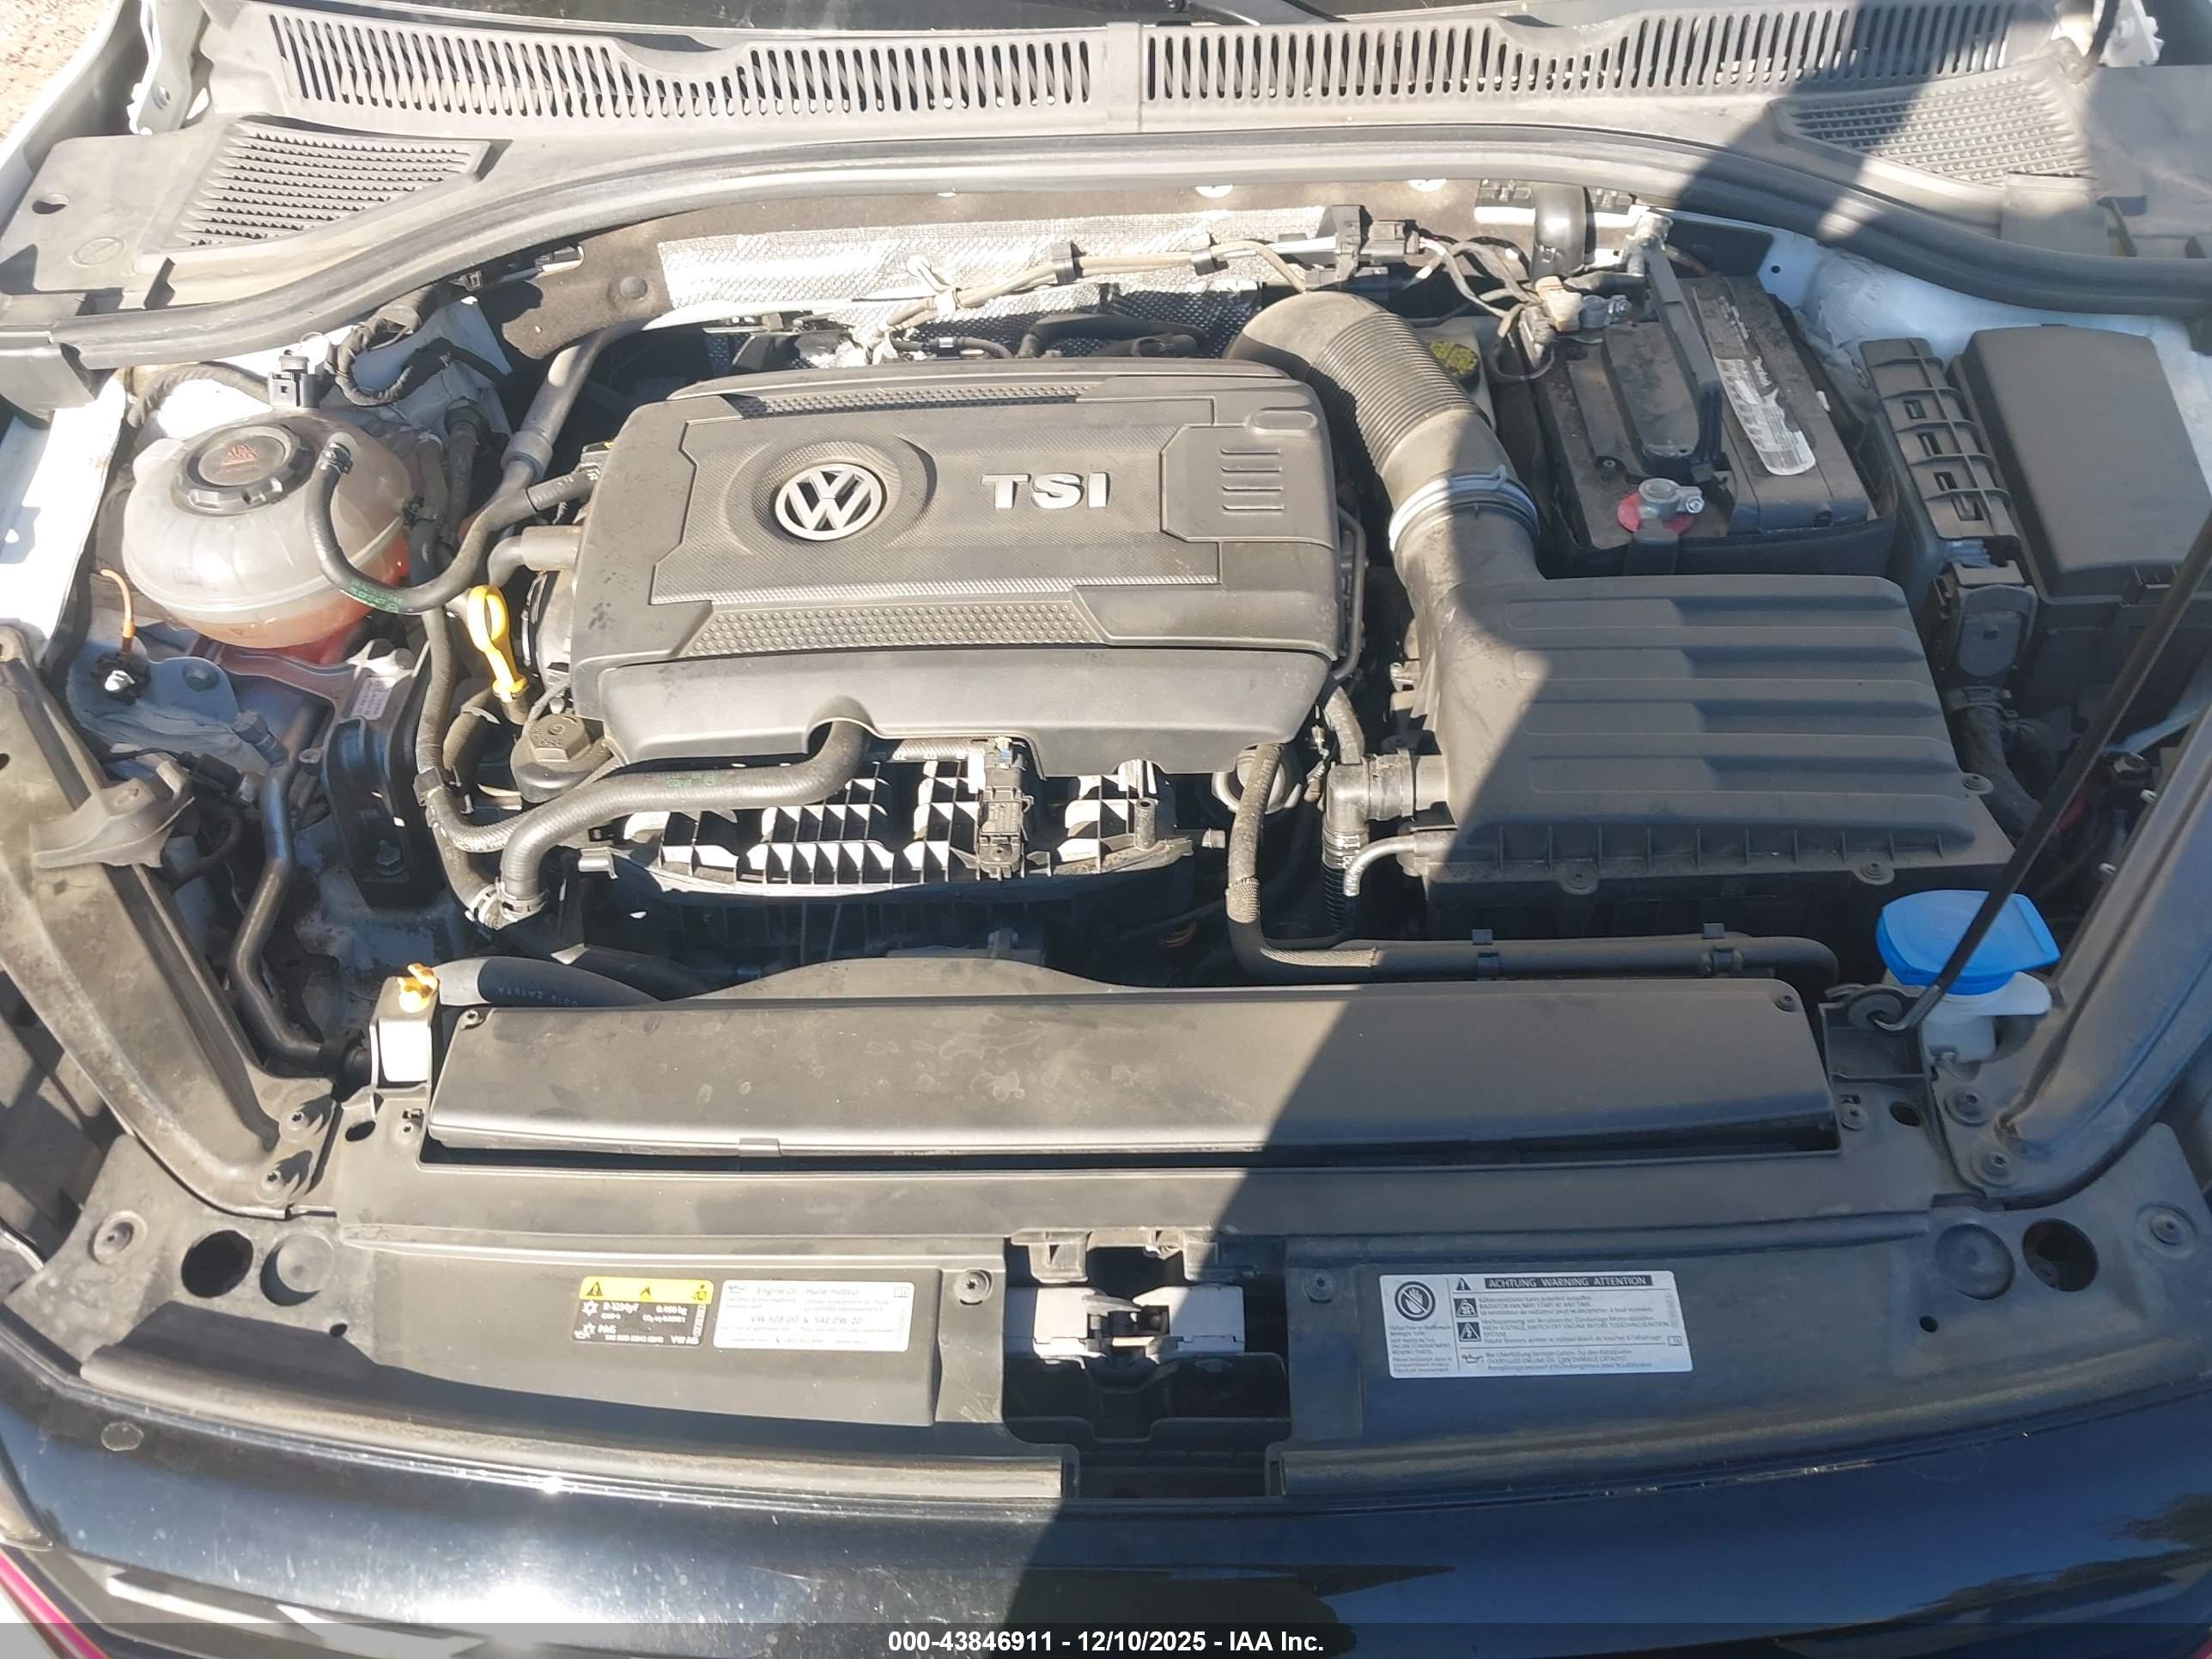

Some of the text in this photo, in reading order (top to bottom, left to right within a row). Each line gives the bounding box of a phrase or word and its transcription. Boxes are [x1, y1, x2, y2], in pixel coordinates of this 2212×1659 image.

[981, 472, 1109, 508] TSI
[1488, 1276, 1647, 1288] ACHTUNG WARNING ATTENTION
